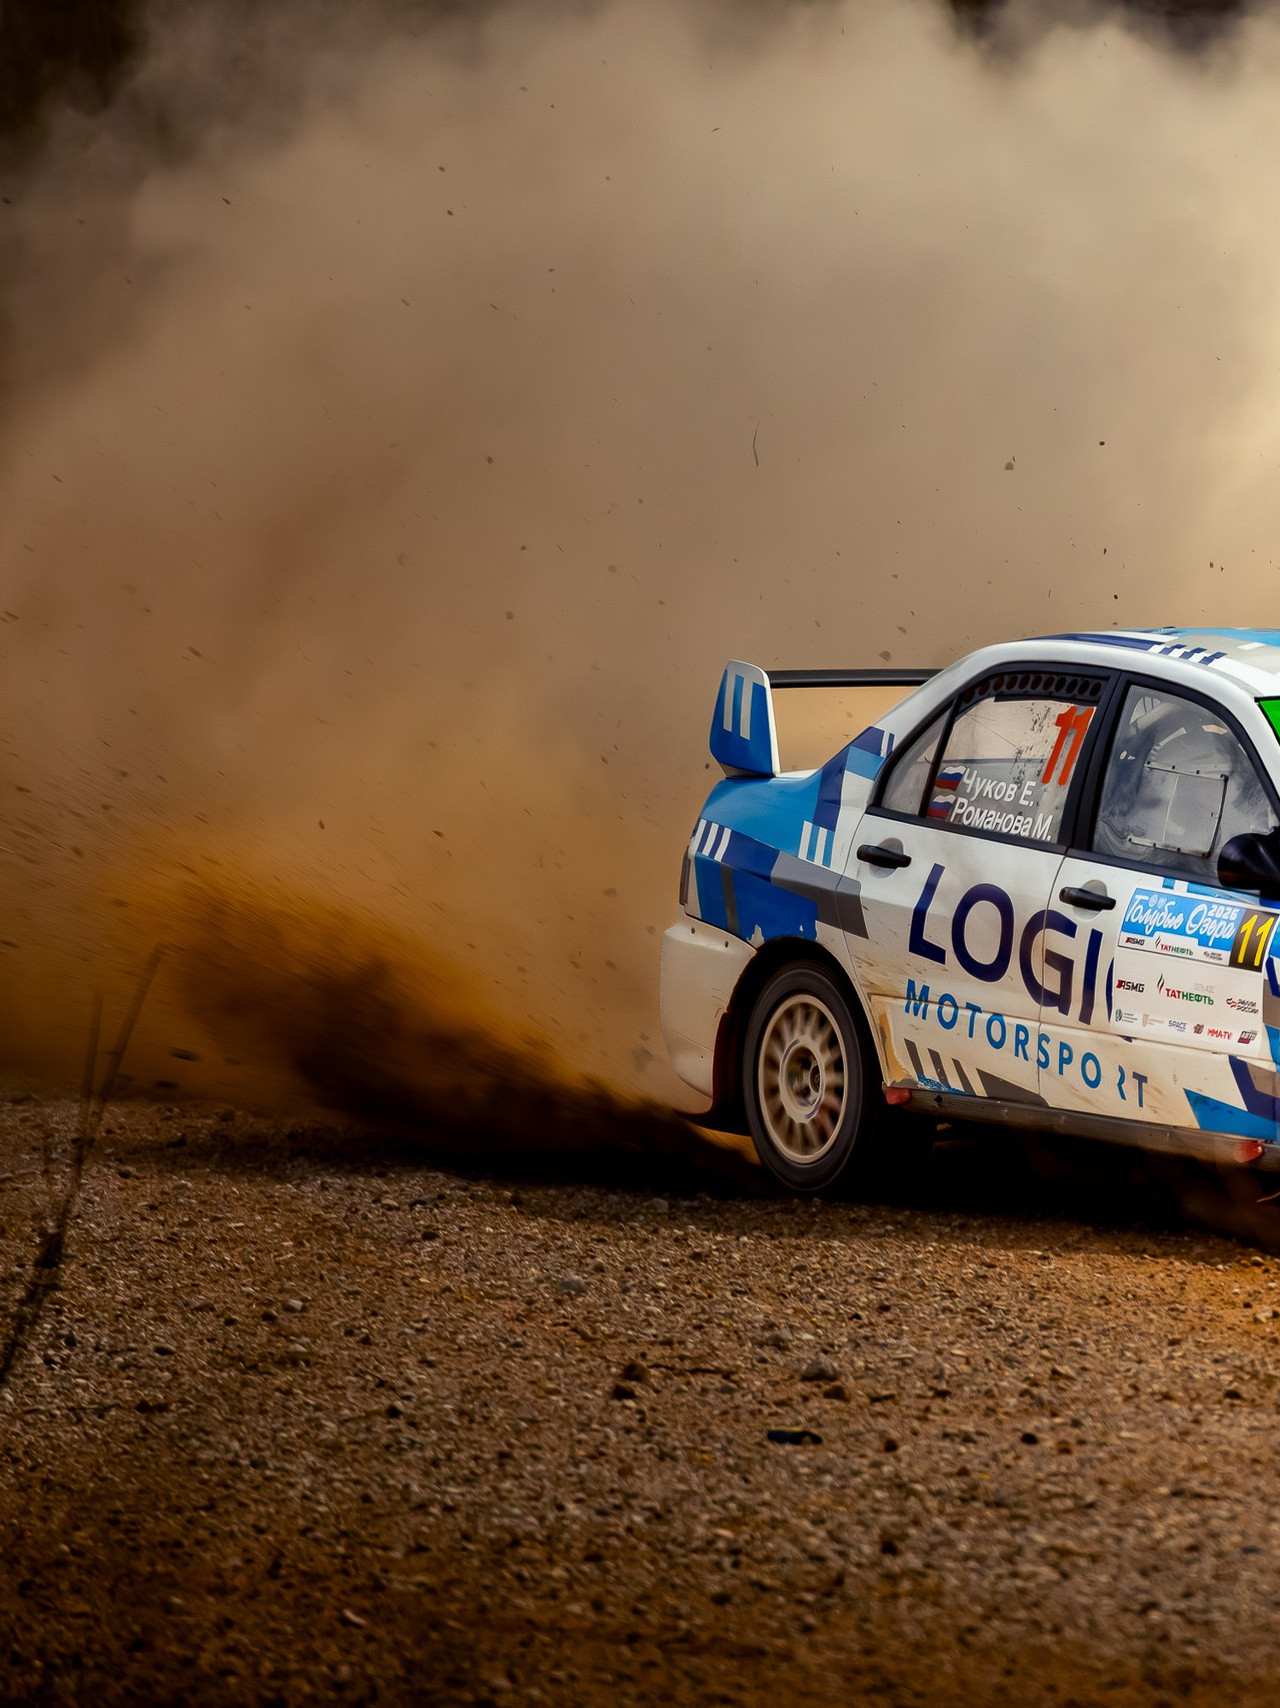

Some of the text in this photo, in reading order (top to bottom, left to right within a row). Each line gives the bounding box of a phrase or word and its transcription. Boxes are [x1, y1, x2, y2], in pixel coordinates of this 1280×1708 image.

[1041, 706, 1095, 786] 11
[963, 768, 1020, 802] Чуков
[951, 797, 1053, 842] Романова М.
[908, 862, 1114, 1025] LOGI
[1125, 894, 1236, 947] Голубые Озера
[1238, 914, 1275, 967] 11
[1160, 943, 1194, 957] ТАТНЕФТЬ
[1165, 987, 1214, 1006] ТАТНЕФТЬ
